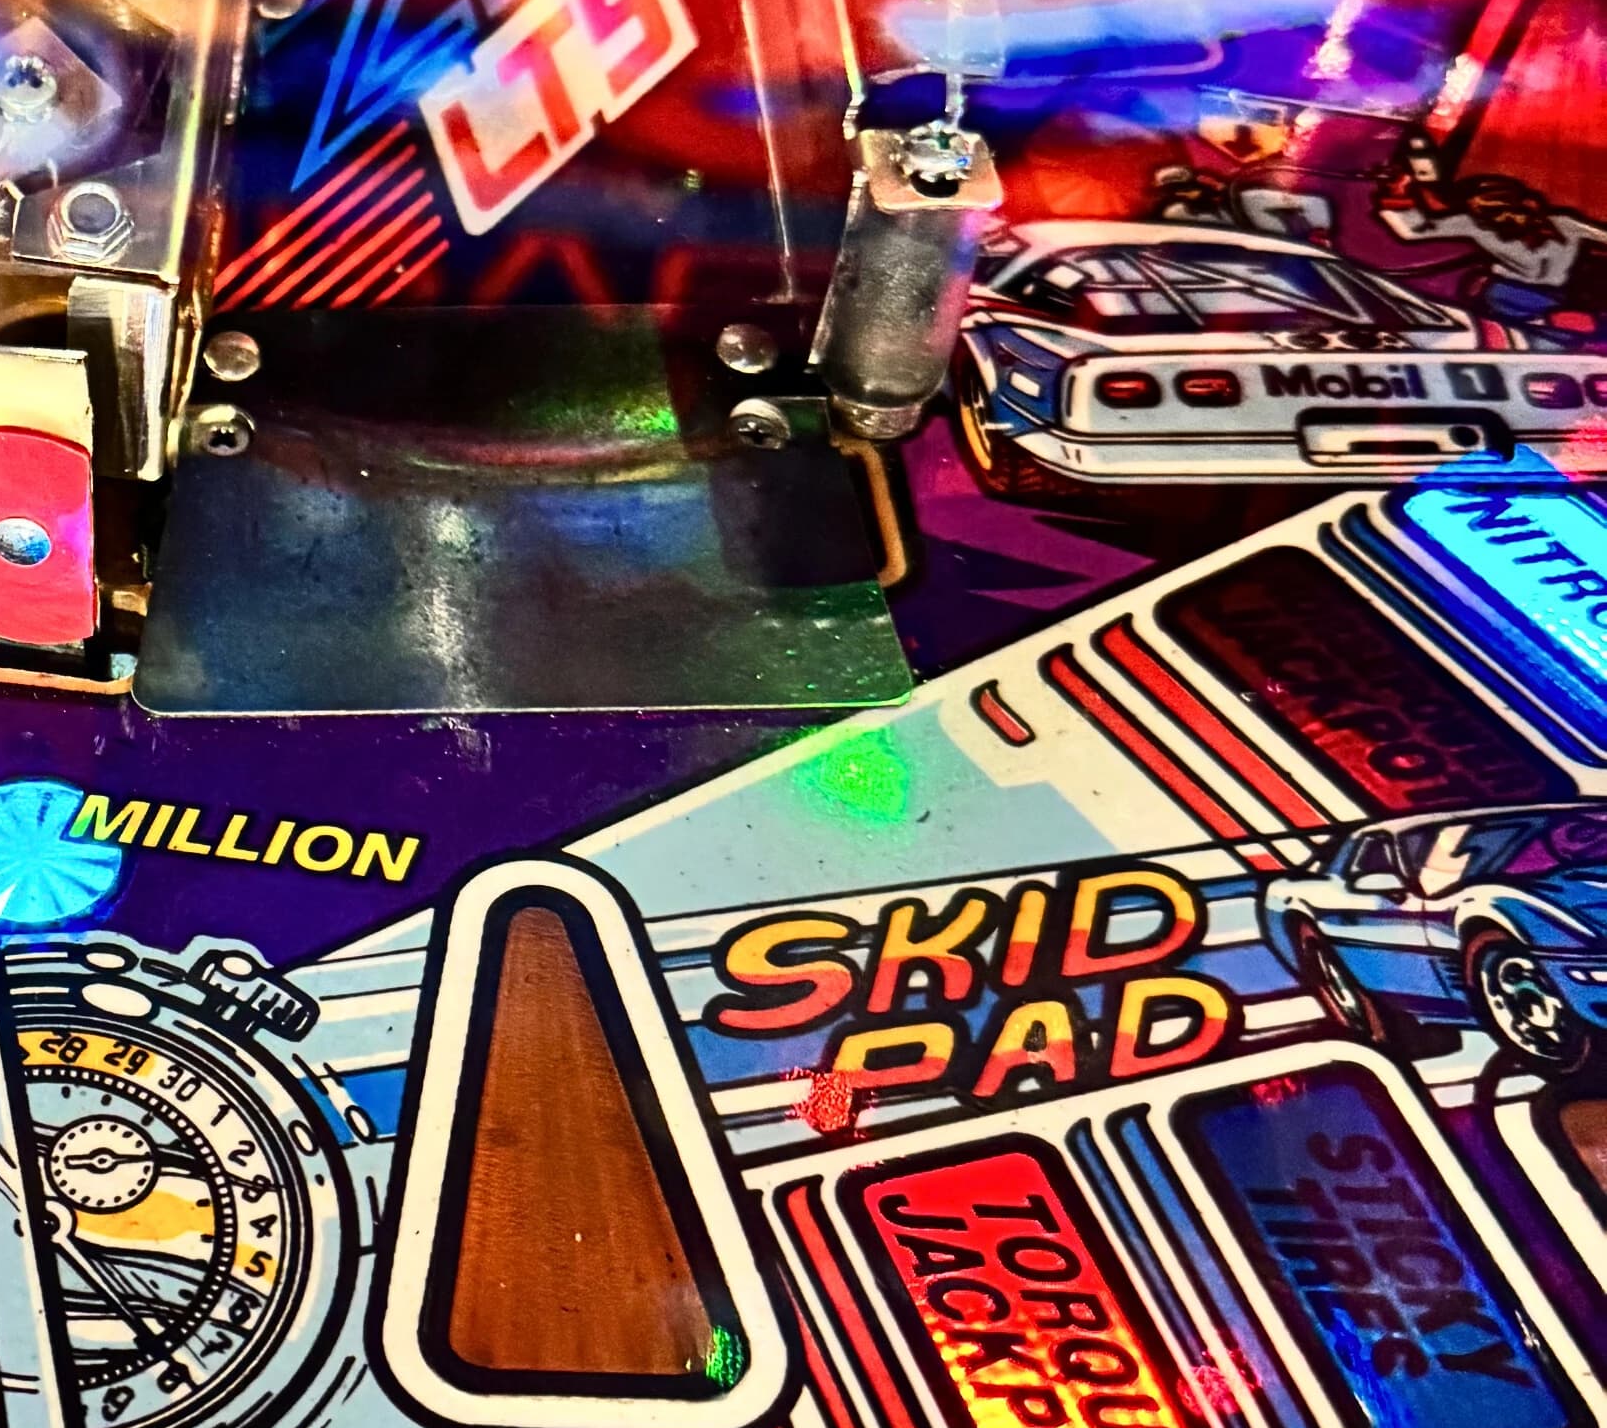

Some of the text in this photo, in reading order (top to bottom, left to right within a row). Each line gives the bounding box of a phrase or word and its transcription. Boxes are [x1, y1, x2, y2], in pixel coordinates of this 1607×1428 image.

[1260, 363, 1428, 400] Mobil
[70, 793, 421, 883] MILLION
[714, 869, 1199, 1032] SKID
[40, 1032, 88, 1064] 28
[826, 977, 1231, 1099] PAD
[103, 1041, 150, 1076] 29
[158, 1067, 202, 1102] 30
[210, 1103, 232, 1127] 1
[227, 1140, 257, 1167] 2
[249, 1213, 278, 1239] 4
[244, 1250, 274, 1278] 5
[1306, 1131, 1536, 1389] STICKY
